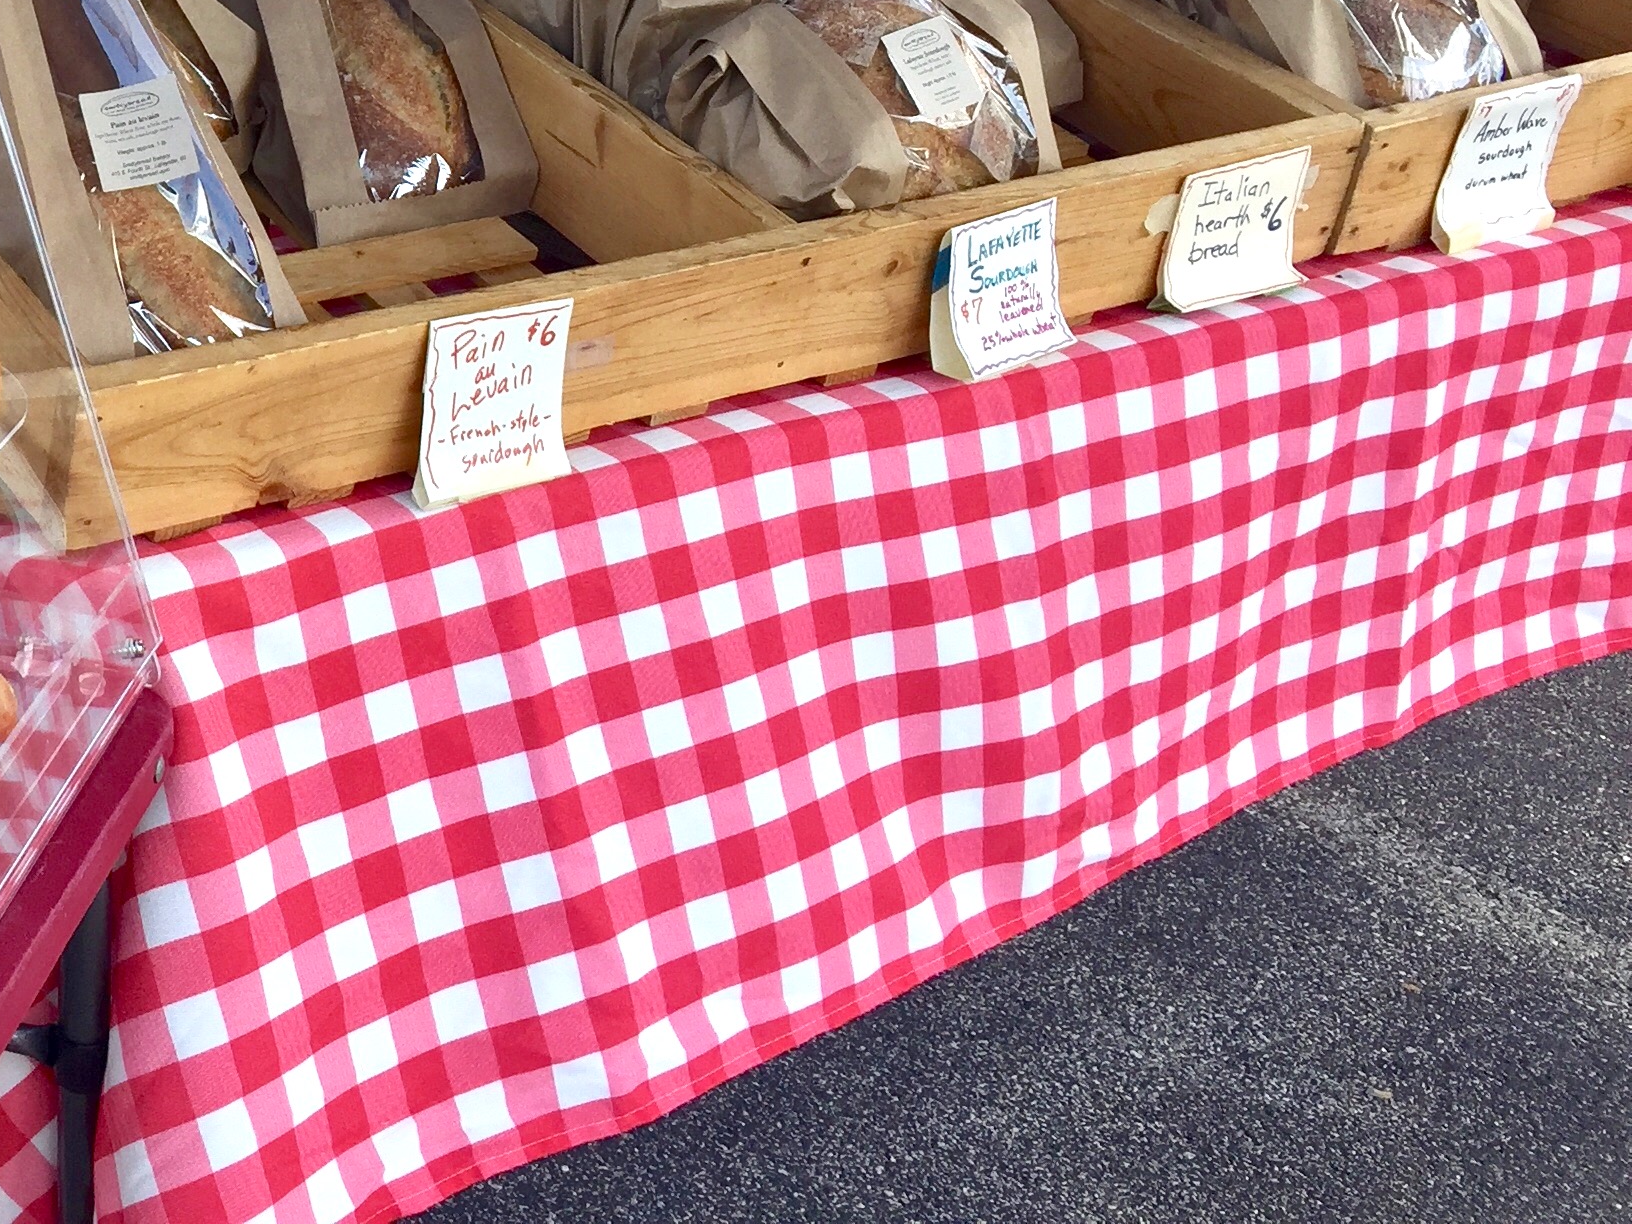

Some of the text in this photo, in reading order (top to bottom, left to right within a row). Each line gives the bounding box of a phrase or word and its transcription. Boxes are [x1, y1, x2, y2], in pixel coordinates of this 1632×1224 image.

[1473, 106, 1548, 144] Amber Wave
[1478, 140, 1533, 165] sourdough
[1197, 174, 1272, 208] Italian
[1465, 176, 1496, 191] durum
[1194, 196, 1288, 237] hearth $6
[1188, 230, 1243, 266] bread
[960, 296, 983, 325] $7
[451, 314, 559, 370] Pain $6
[474, 363, 496, 385] au
[461, 433, 545, 474] sourdough
